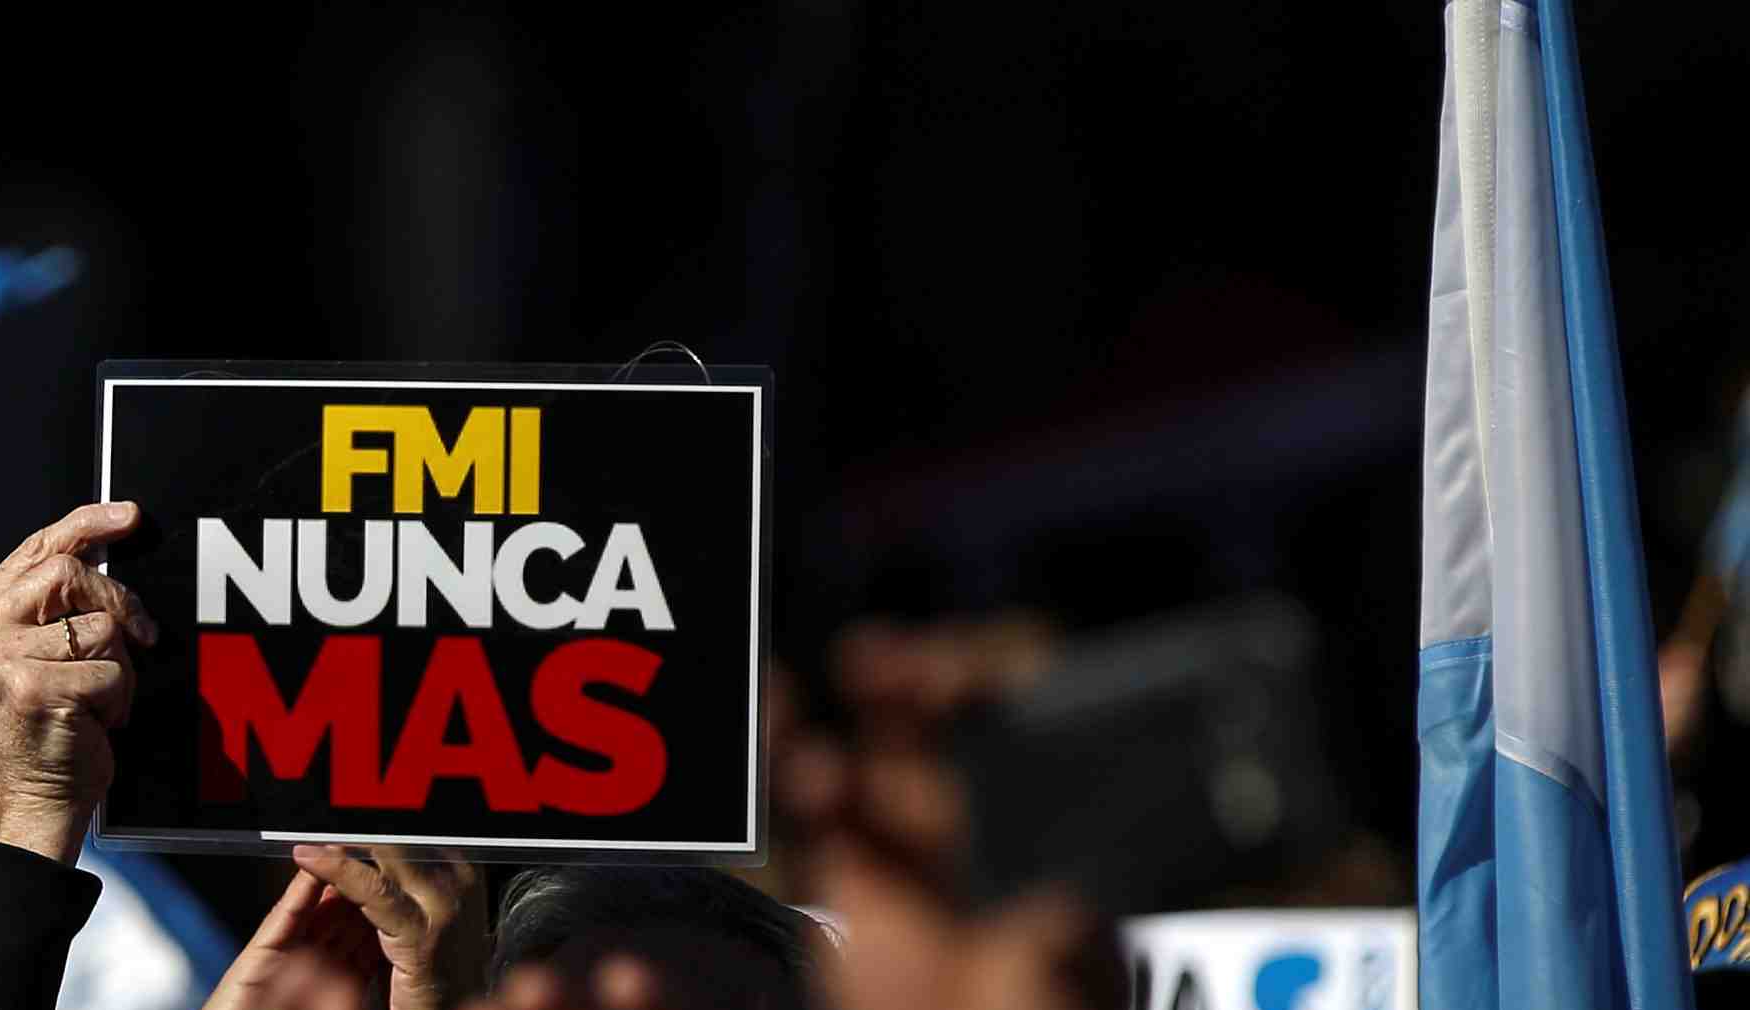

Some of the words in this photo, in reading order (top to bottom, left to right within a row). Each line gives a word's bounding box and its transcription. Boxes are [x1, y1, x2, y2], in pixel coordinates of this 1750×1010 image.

[321, 404, 541, 515] FMI
[196, 517, 677, 631] NUNCA
[197, 632, 668, 817] MAS
